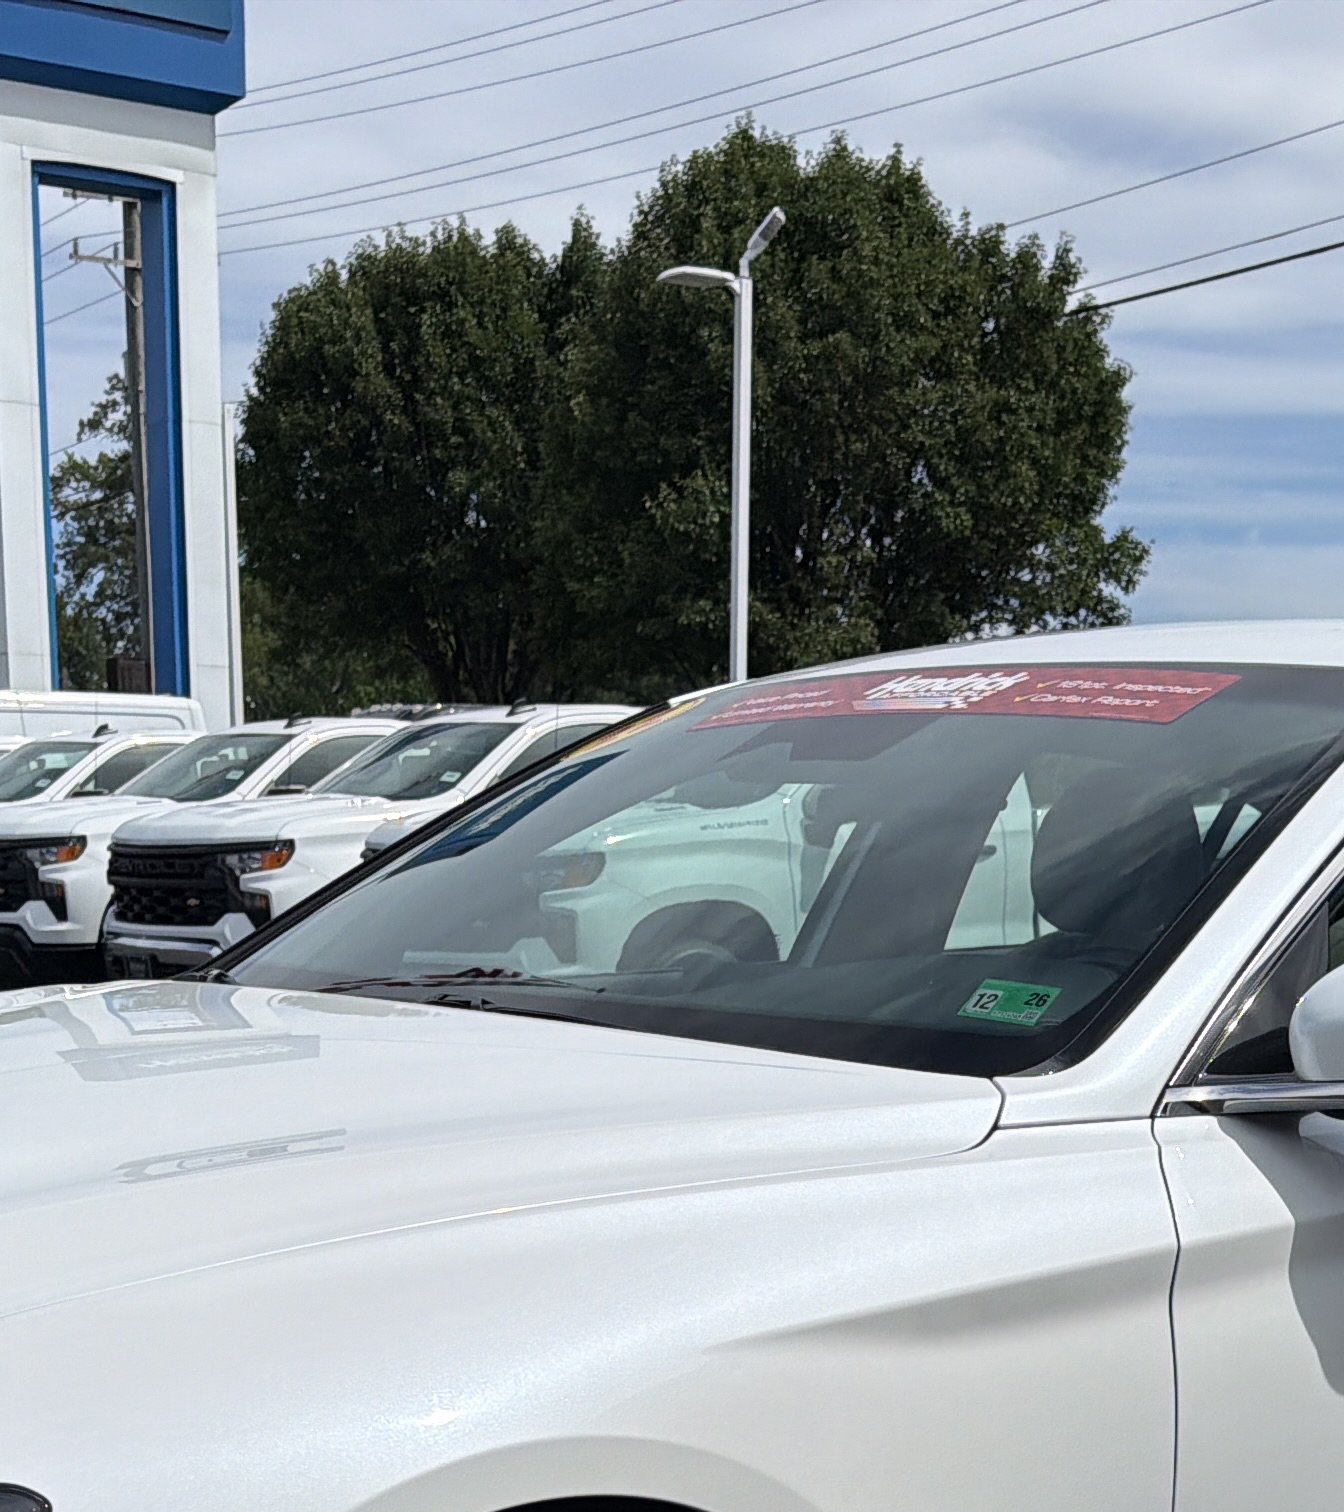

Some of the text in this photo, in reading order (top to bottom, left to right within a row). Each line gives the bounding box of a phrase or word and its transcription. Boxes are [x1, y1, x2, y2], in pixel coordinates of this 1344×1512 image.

[863, 671, 1031, 699] Hendrick
[1112, 681, 1213, 696] Inspected
[1030, 692, 1160, 707] Carfax Report
[972, 992, 1051, 1010] 12 26
